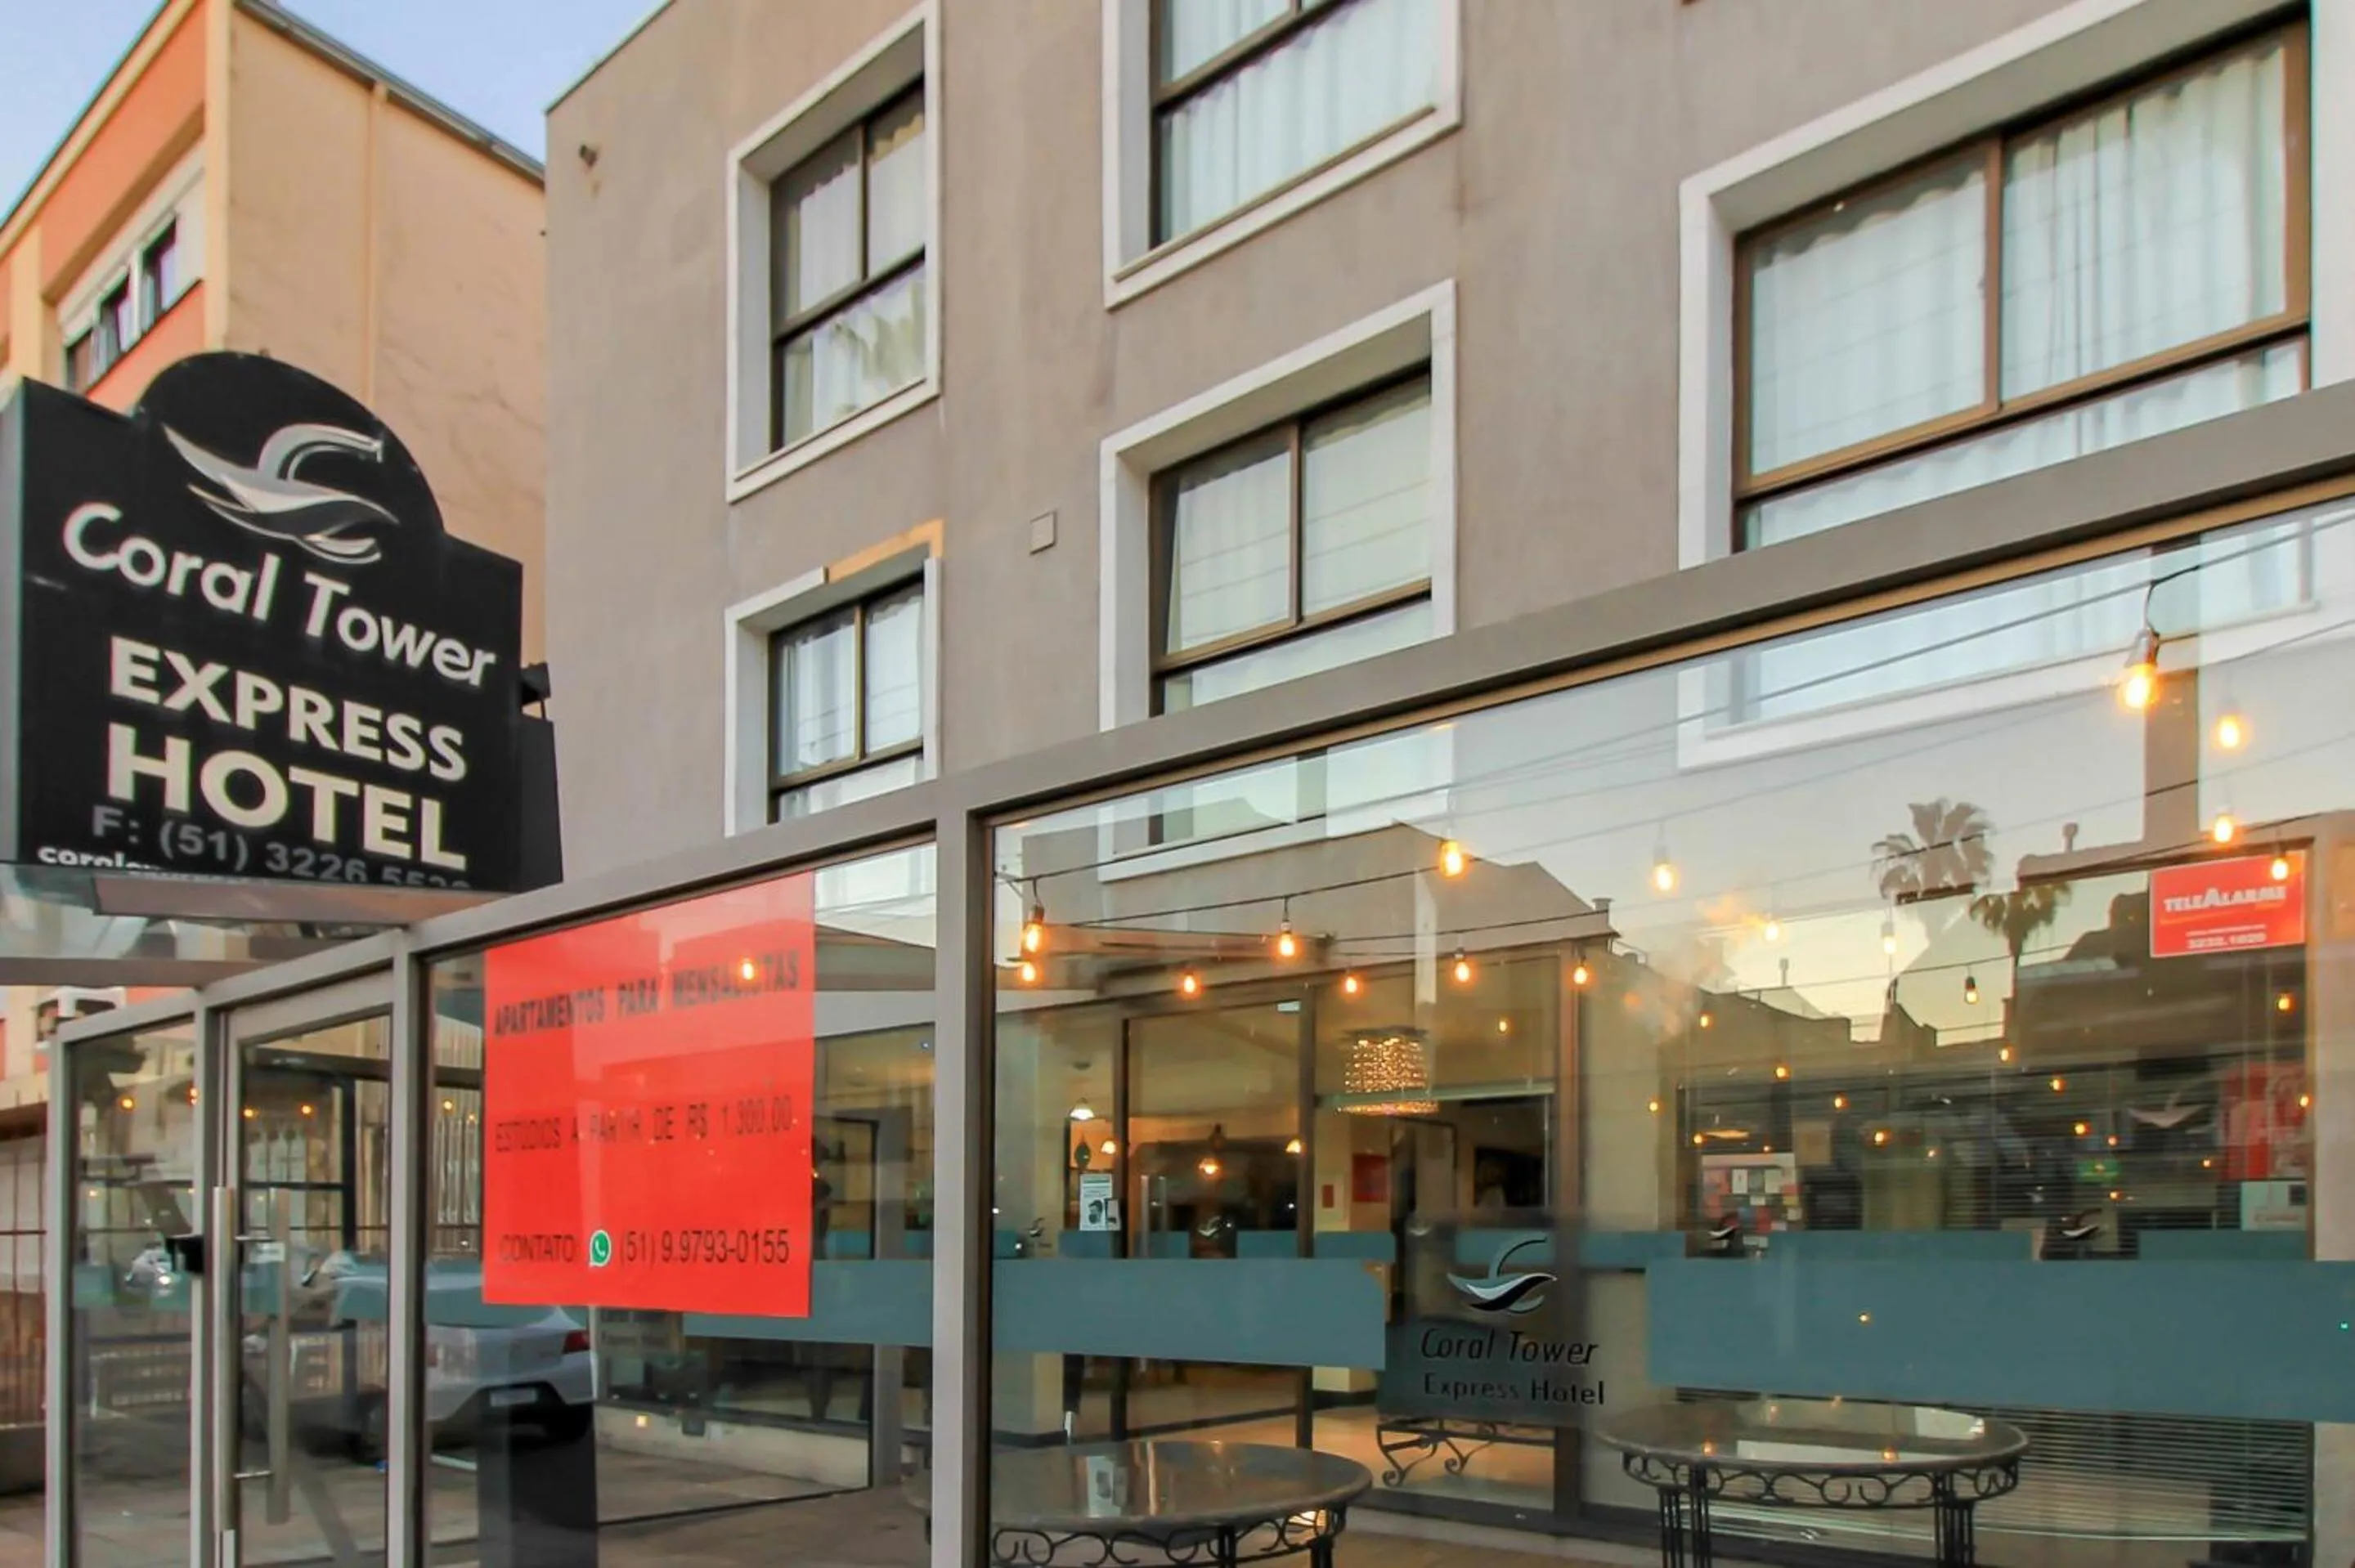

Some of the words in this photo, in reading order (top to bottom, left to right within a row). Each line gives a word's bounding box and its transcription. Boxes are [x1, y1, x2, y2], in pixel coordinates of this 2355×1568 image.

[63, 502, 280, 620] Coral
[303, 572, 496, 687] Tower
[110, 635, 468, 782] EXPRESS
[108, 722, 468, 871] HOTEL
[92, 804, 140, 844] F:
[159, 820, 249, 871] (51)
[617, 979, 660, 1019] PARA
[620, 1230, 654, 1269] (51)
[661, 1229, 789, 1264] 9.9793-0155
[1420, 1328, 1495, 1361] Coral
[1509, 1331, 1598, 1365] Tower
[1424, 1373, 1519, 1400] Express
[1531, 1379, 1604, 1404] Hotel
